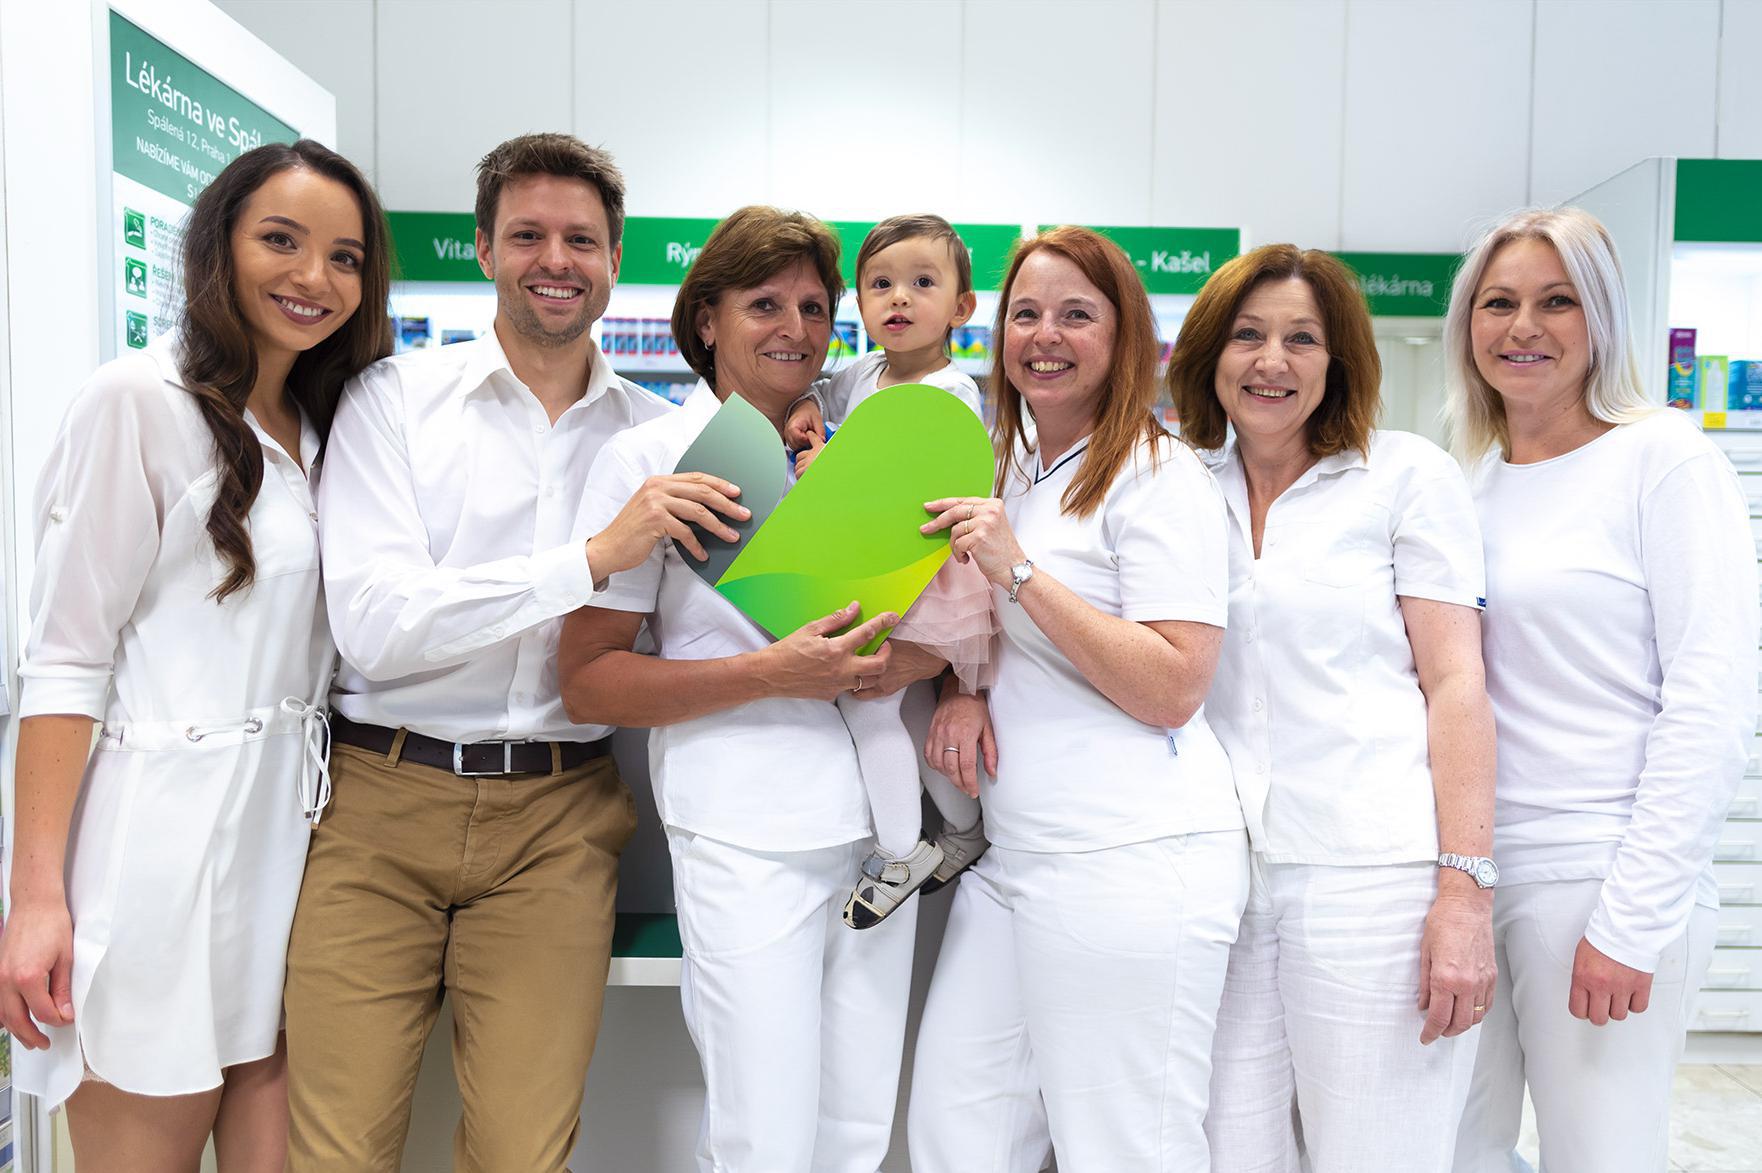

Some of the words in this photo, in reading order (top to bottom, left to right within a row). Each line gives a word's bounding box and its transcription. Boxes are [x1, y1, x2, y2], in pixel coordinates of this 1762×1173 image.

[126, 51, 204, 126] Lékárna
[206, 109, 226, 139] ve
[229, 116, 264, 155] Spál
[136, 136, 181, 172] NABÍZÍME
[181, 159, 200, 182] VÁM
[147, 108, 184, 142] Spálená
[201, 138, 225, 165] Praha
[433, 238, 475, 260] Vita
[1151, 250, 1210, 273] Kašel
